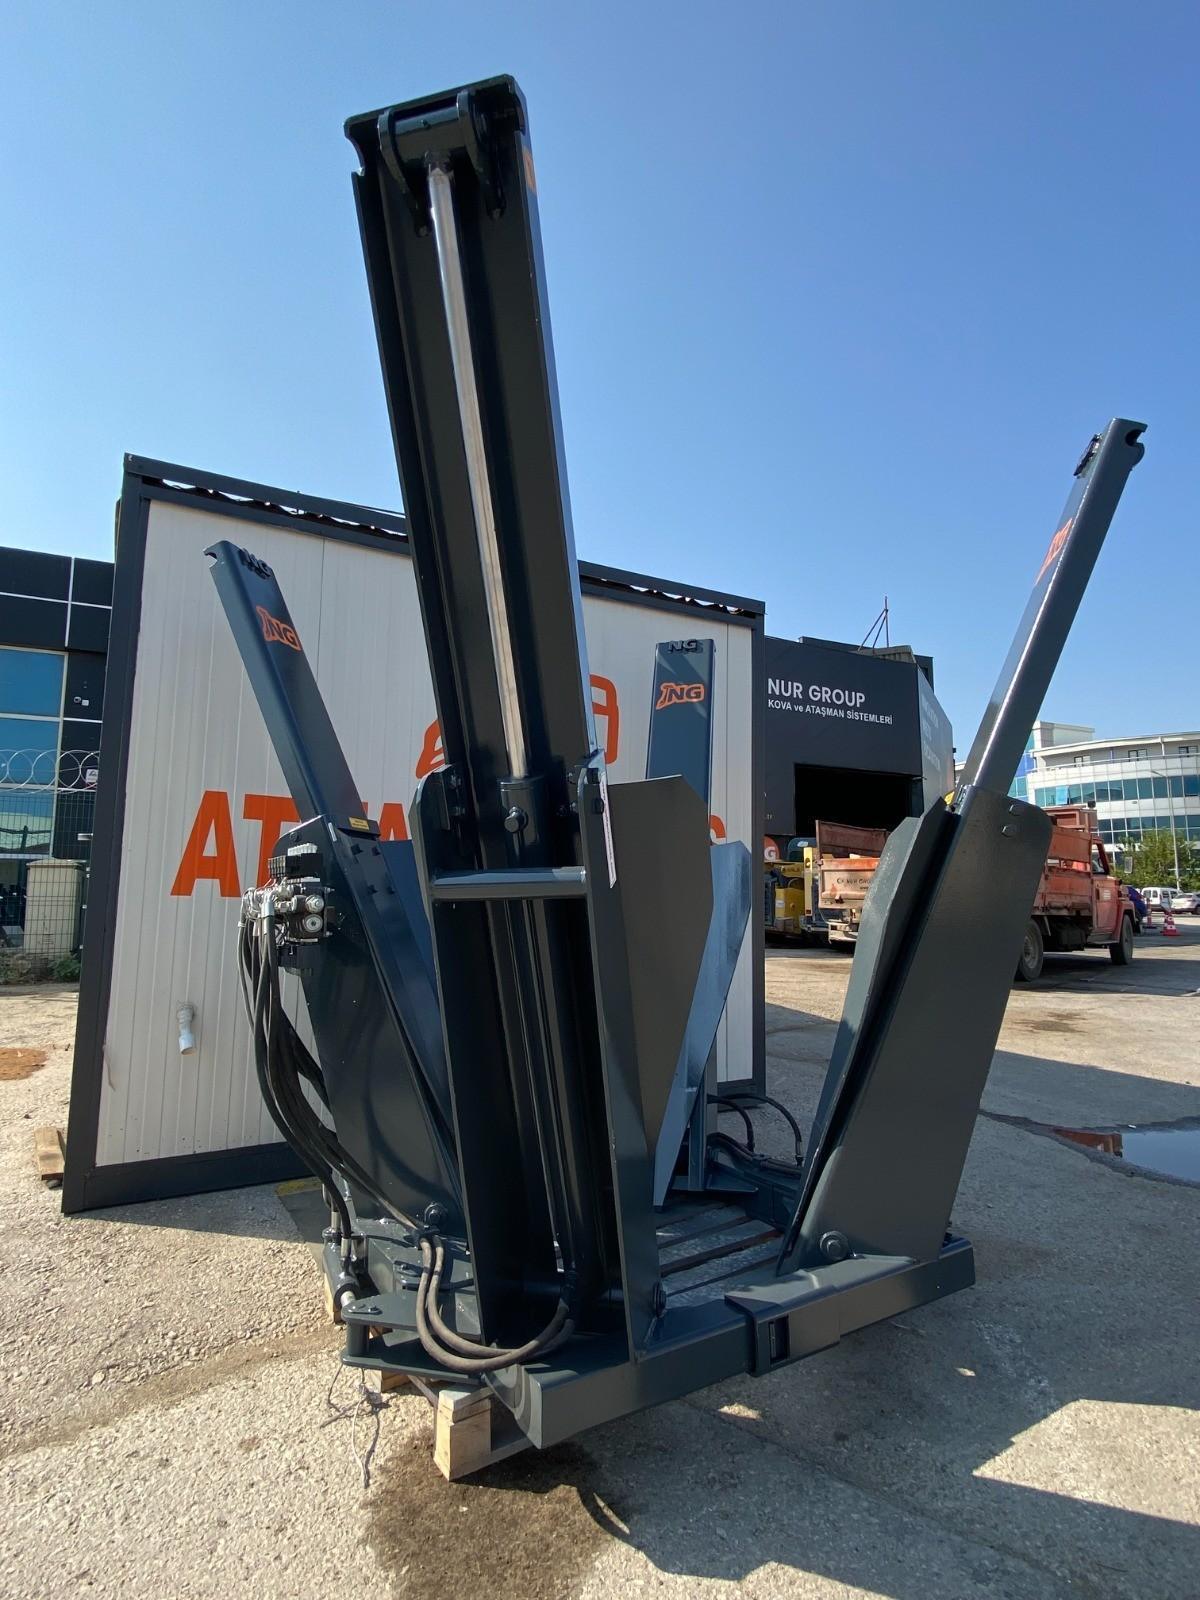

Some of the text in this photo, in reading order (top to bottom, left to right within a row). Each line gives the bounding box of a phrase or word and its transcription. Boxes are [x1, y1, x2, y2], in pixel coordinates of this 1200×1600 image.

[768, 678, 866, 708] NUR GROUP
[768, 699, 792, 711] KOVA
[805, 704, 845, 718] ATAŞMAN
[847, 709, 893, 725] SİSTEMLERİ
